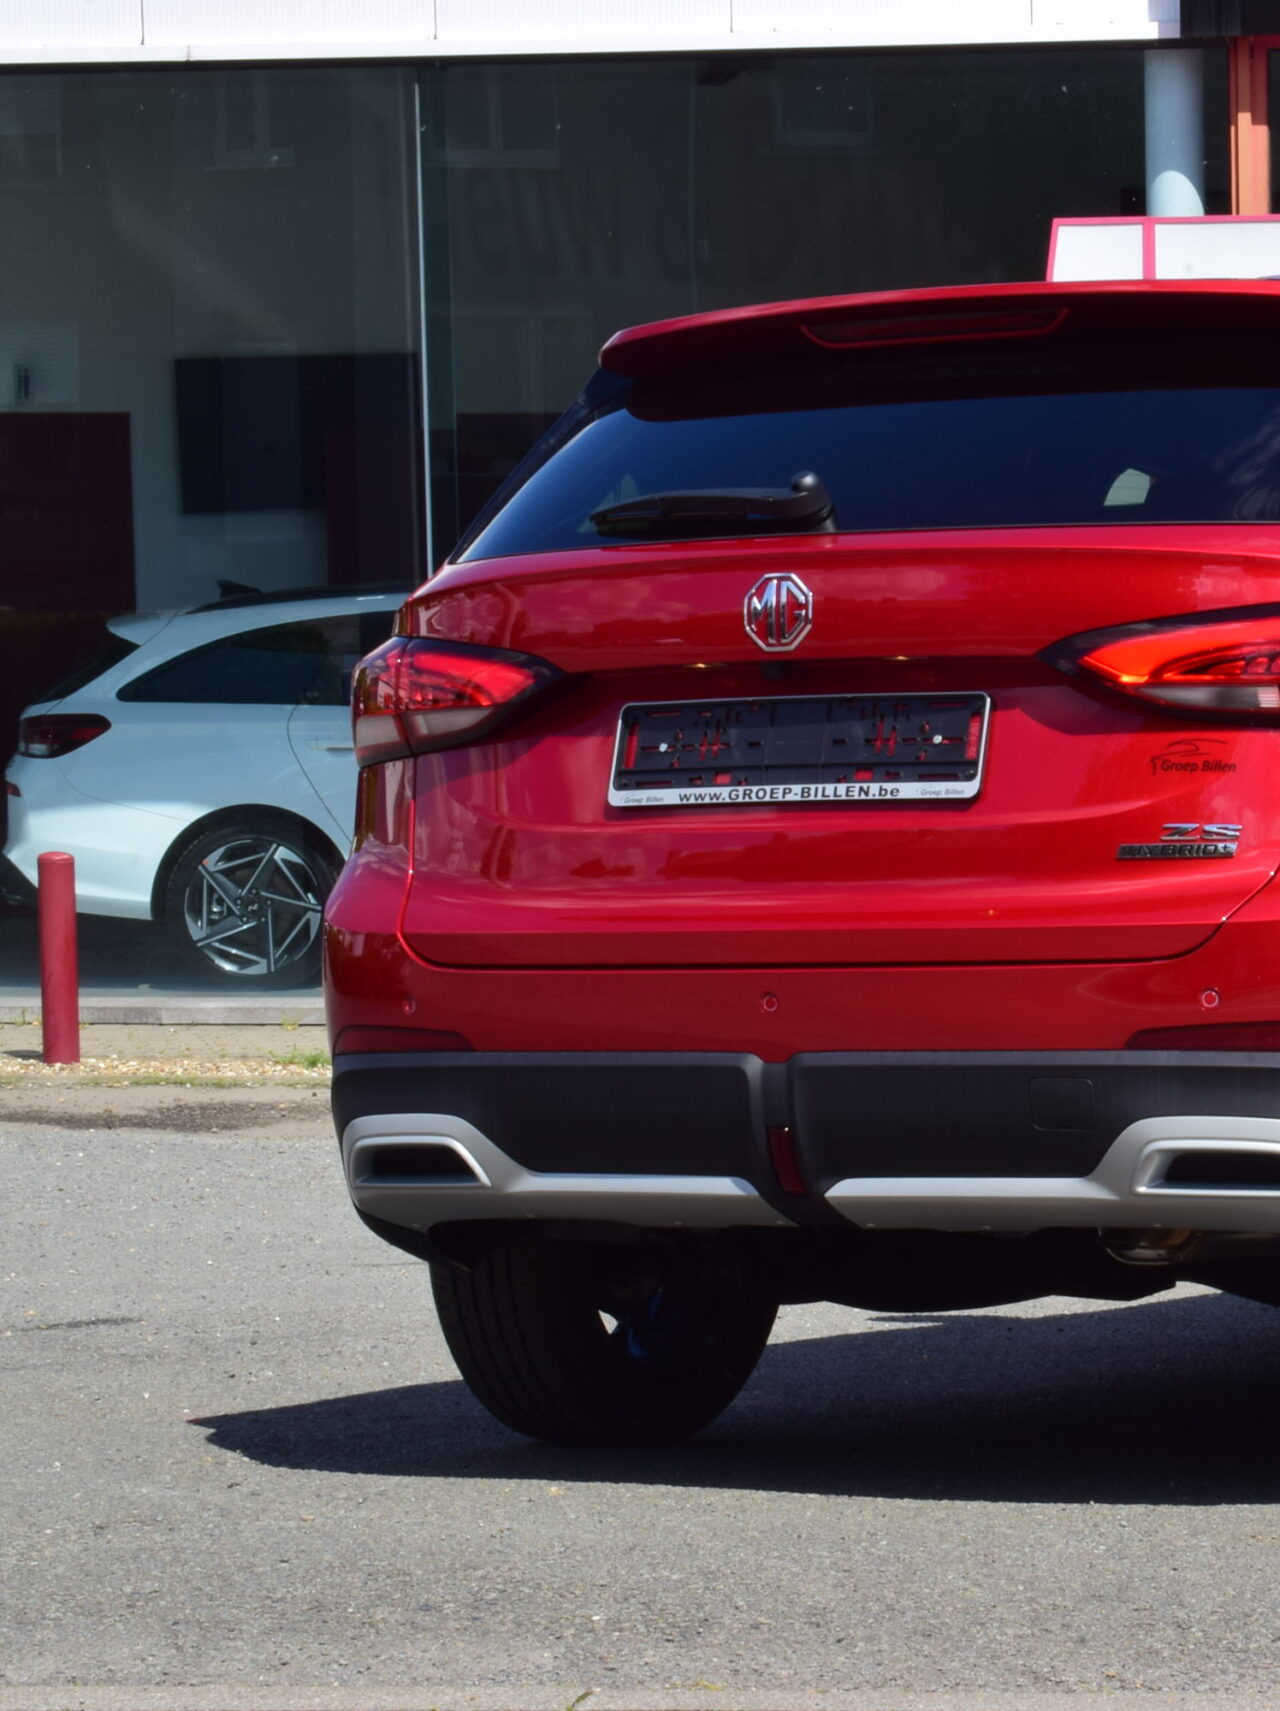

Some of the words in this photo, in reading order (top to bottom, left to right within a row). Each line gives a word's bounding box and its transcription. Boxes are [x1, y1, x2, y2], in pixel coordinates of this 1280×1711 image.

[749, 578, 807, 644] MG
[1161, 760, 1199, 774] Groep
[1201, 760, 1237, 772] Billen
[679, 785, 900, 803] www.GROEP-BILLEN.be
[1160, 823, 1243, 841] ZS
